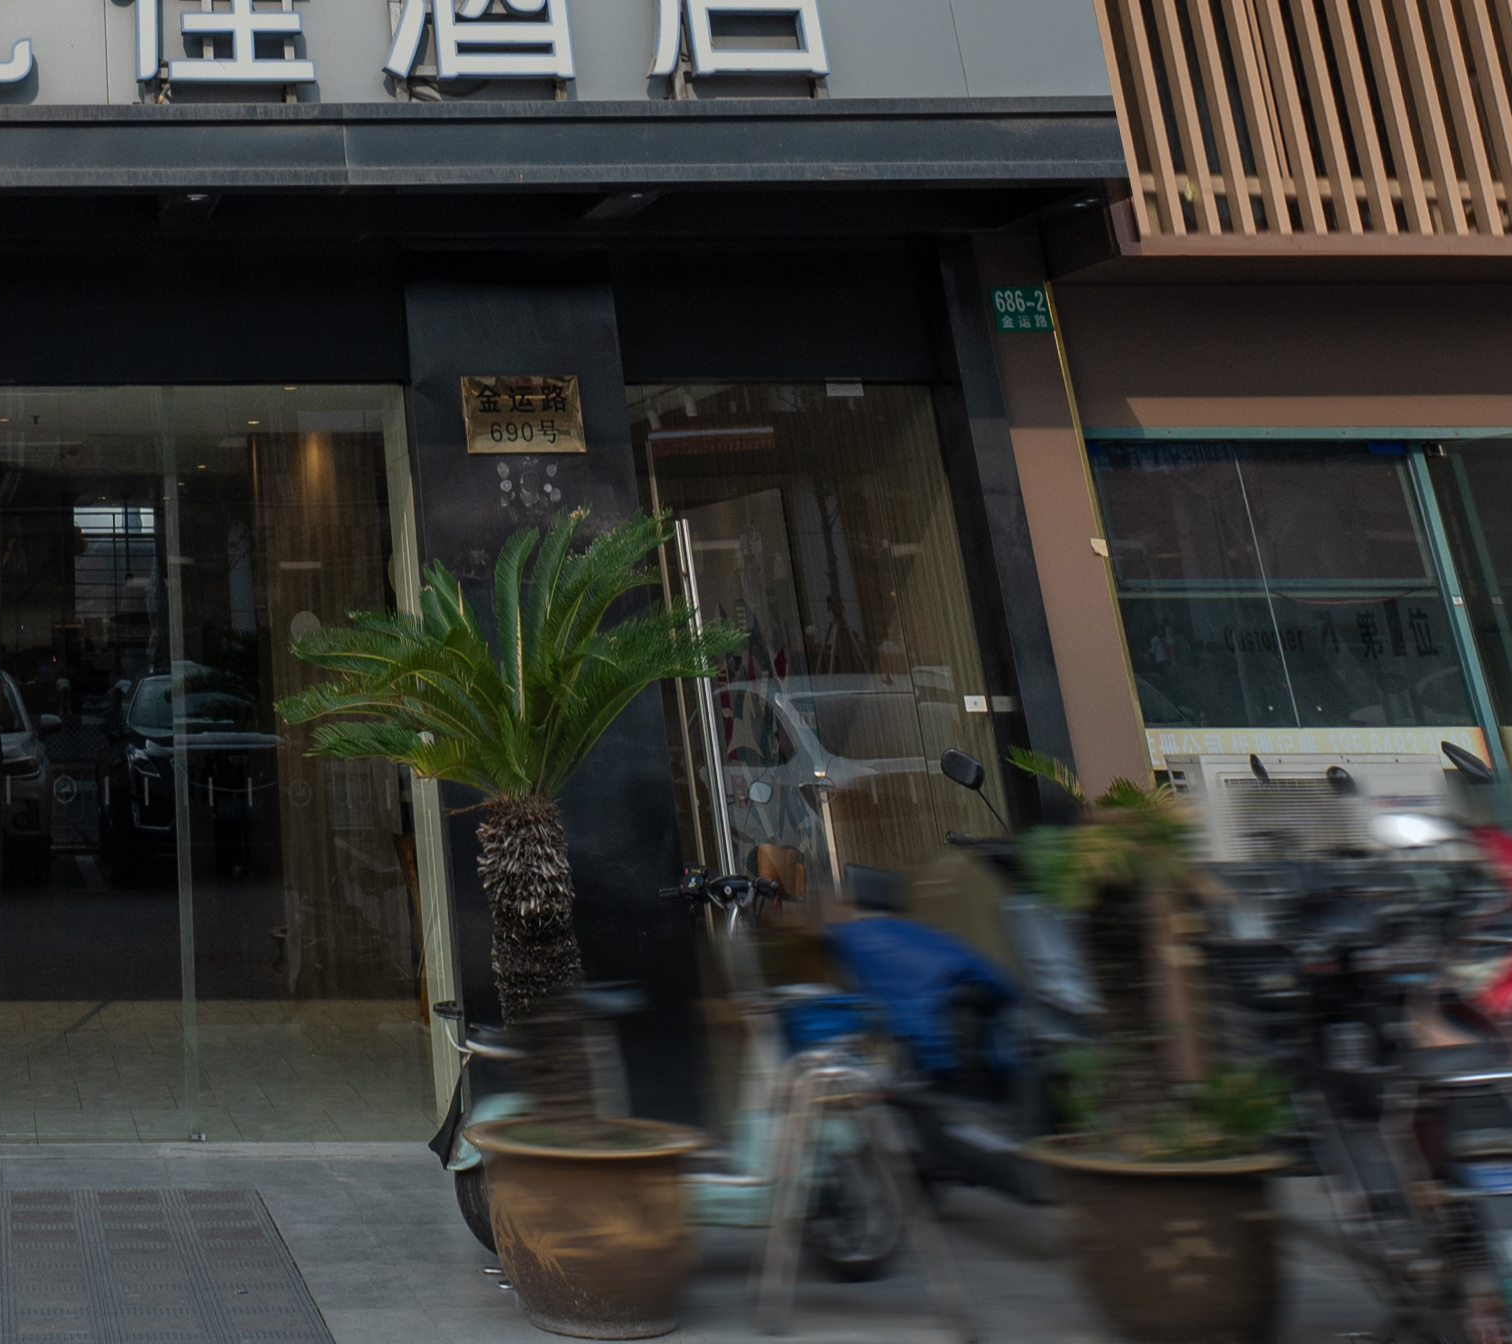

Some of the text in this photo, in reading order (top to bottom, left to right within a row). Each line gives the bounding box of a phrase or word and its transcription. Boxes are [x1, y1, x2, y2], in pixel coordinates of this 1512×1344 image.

[995, 290, 1046, 312] 686-2
[1002, 315, 1048, 328] 金运路
[476, 384, 568, 414] 金运路
[490, 419, 559, 445] 690号
